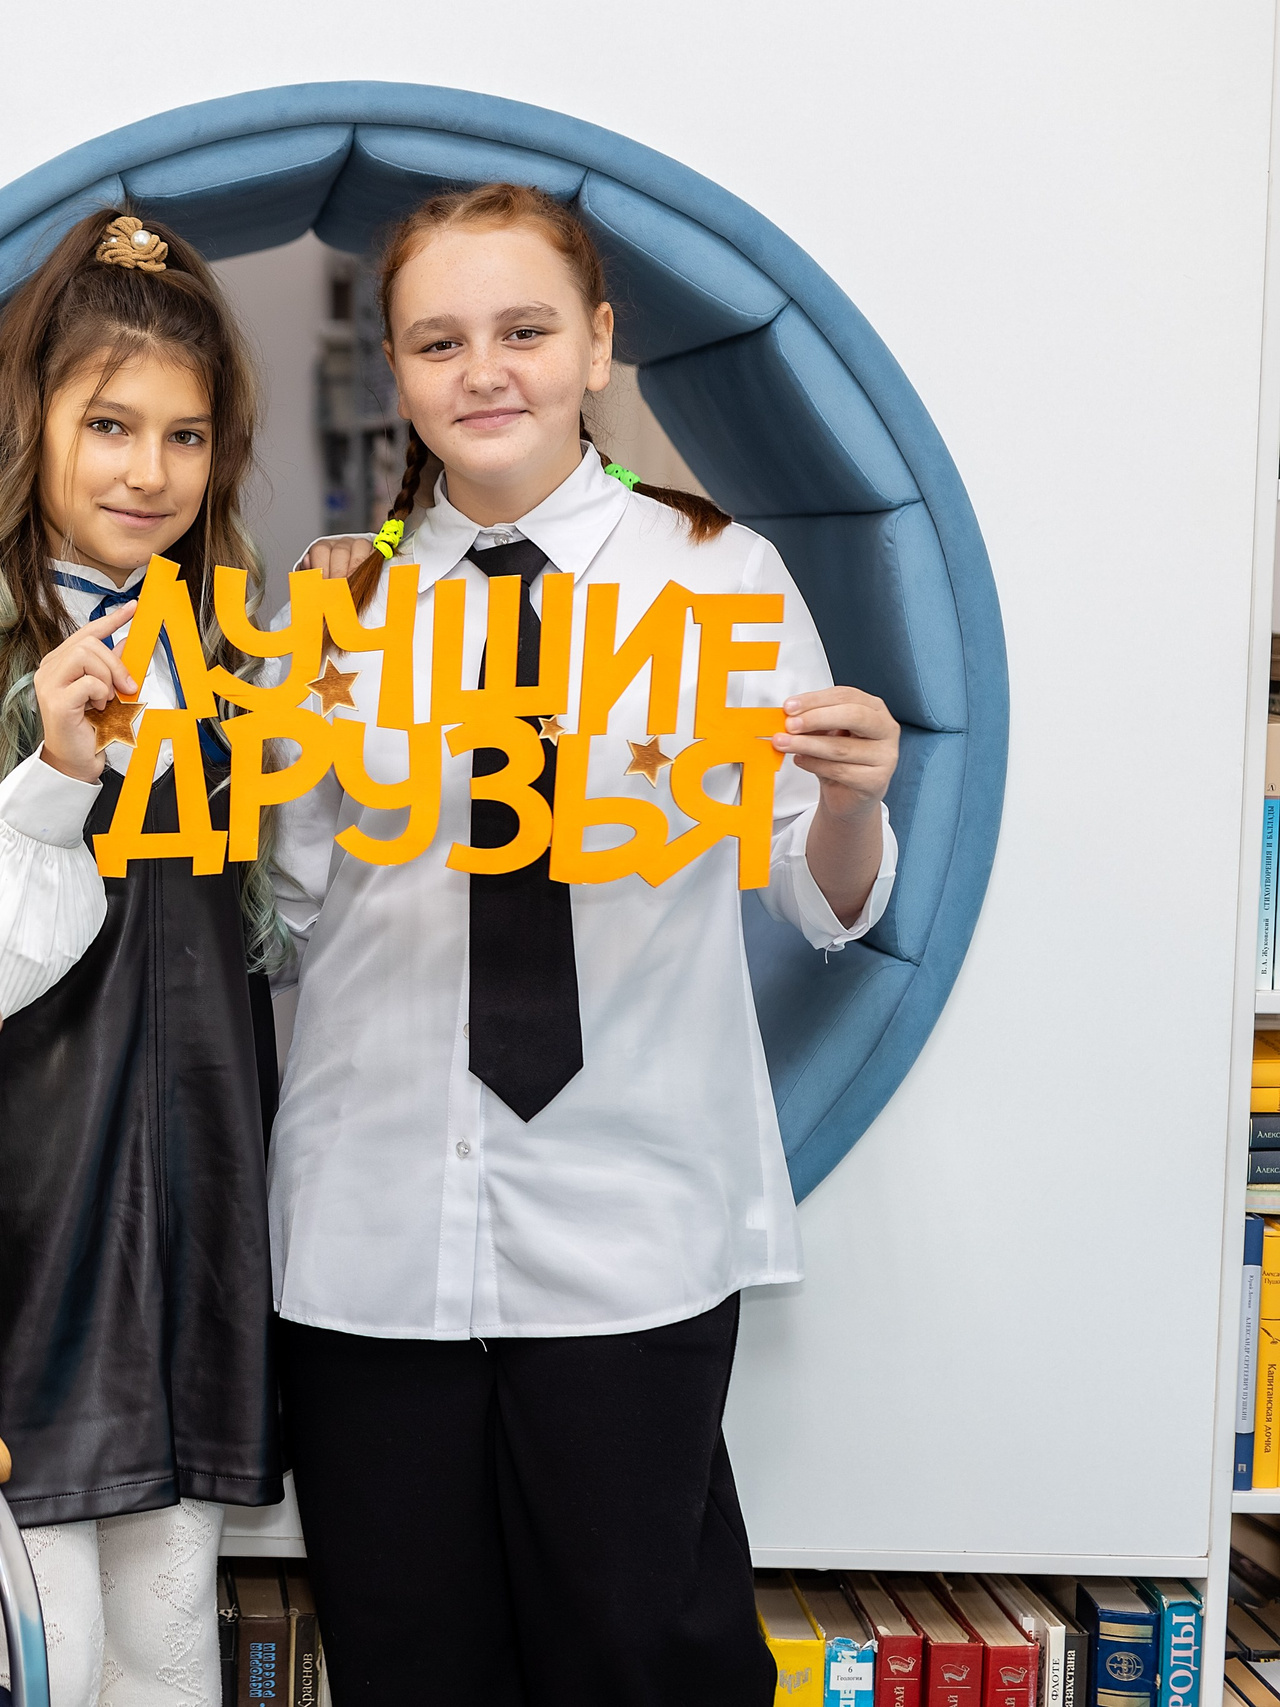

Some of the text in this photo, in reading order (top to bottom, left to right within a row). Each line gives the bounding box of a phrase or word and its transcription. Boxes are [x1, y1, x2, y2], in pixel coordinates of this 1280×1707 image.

[116, 553, 787, 739] ЛУЧШИЕ
[92, 708, 784, 890] ДРУЗЬЯ
[1263, 1364, 1276, 1454] Капитанская дочка
[249, 1643, 263, 1698] ИСТОРИЯ
[263, 1643, 276, 1698] РОССИИ
